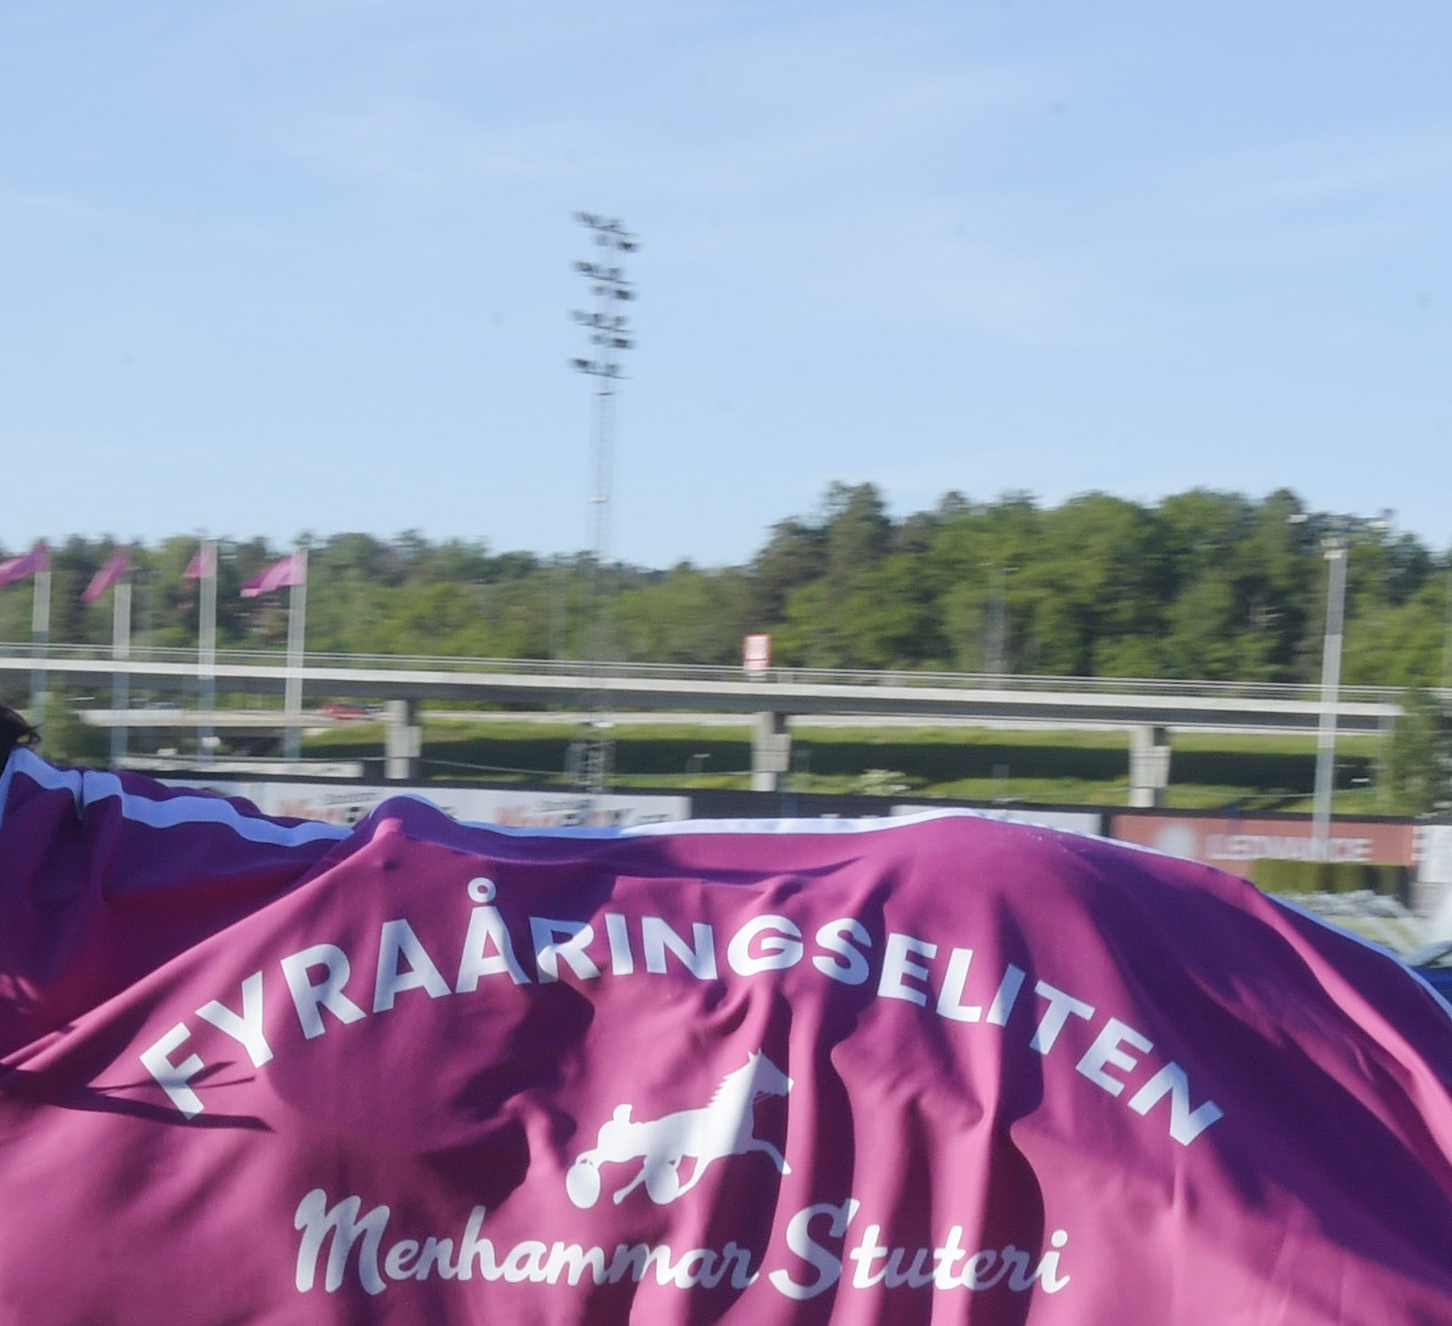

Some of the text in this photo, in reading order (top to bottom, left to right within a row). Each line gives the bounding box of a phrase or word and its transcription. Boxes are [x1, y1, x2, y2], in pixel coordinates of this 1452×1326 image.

[139, 877, 1223, 1147] FYRAÅRINGSELITEN
[294, 1188, 1071, 1300] Menhammar Stuteri
